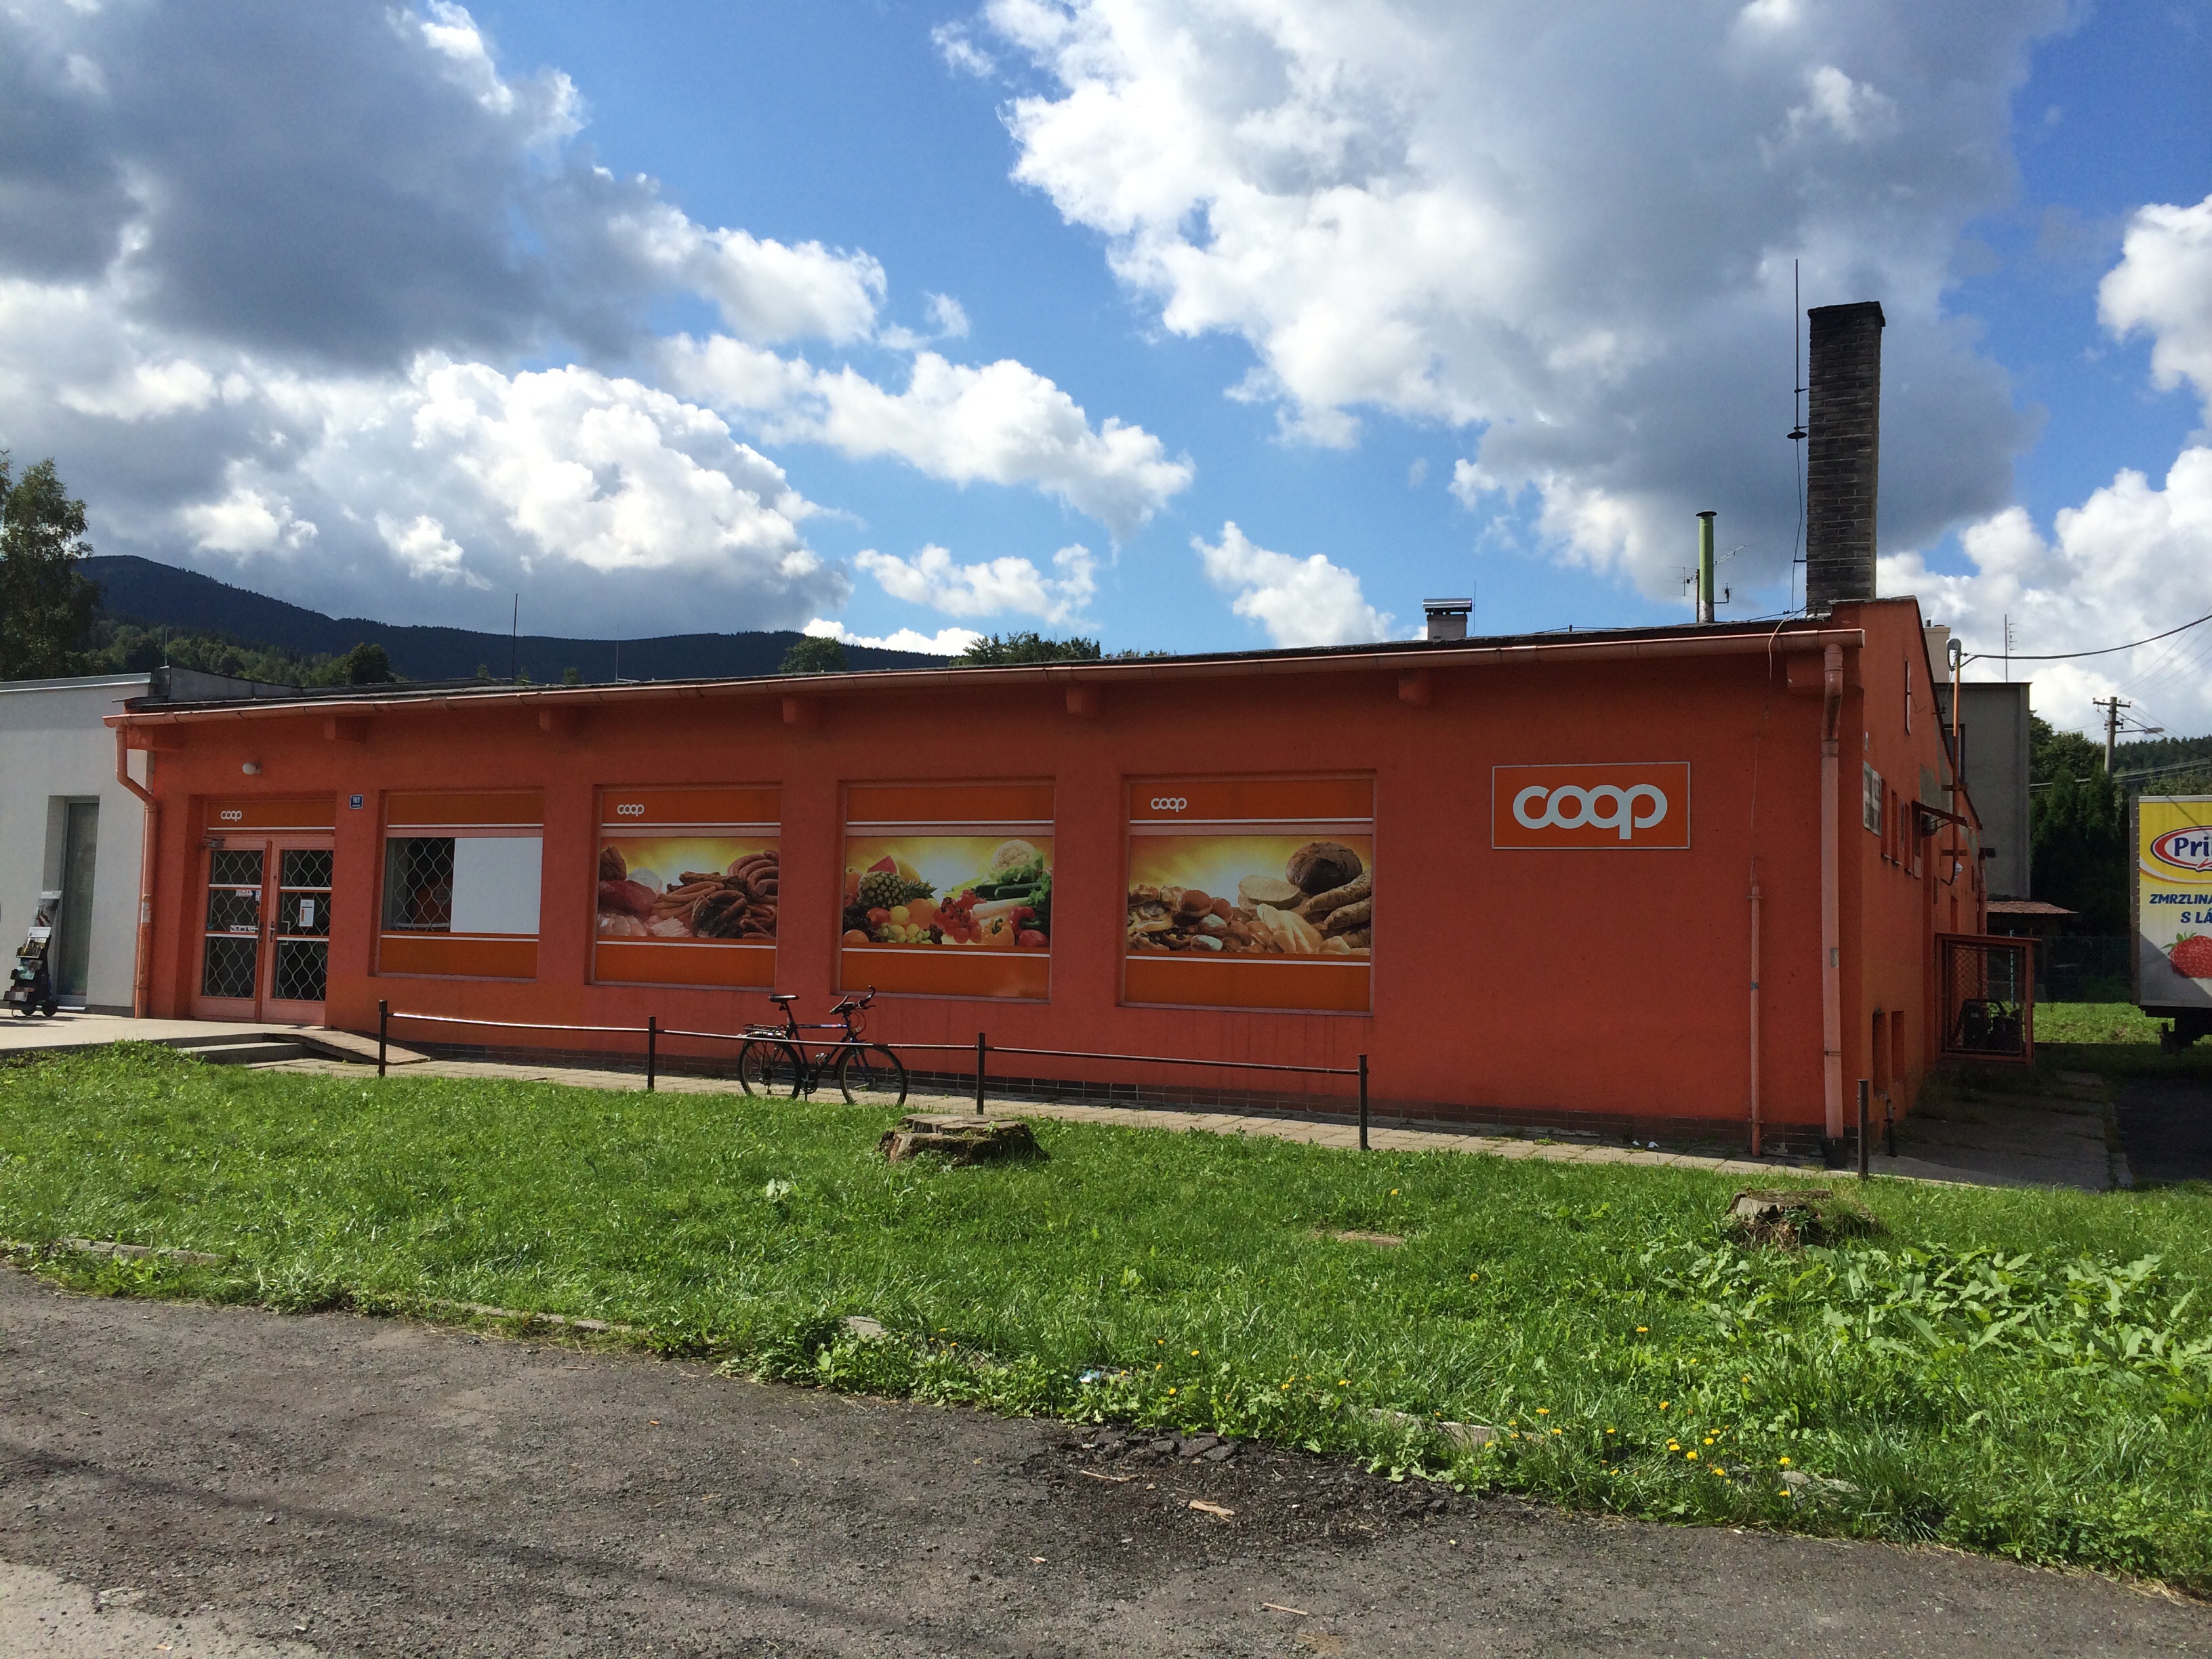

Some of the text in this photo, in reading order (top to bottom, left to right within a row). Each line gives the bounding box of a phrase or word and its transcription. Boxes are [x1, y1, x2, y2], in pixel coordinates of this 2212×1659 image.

[617, 804, 644, 817] coop
[1151, 798, 1187, 812] coop
[220, 810, 243, 822] coop
[1513, 784, 1668, 840] coop
[2174, 836, 2212, 857] Pri
[2180, 912, 2191, 923] S
